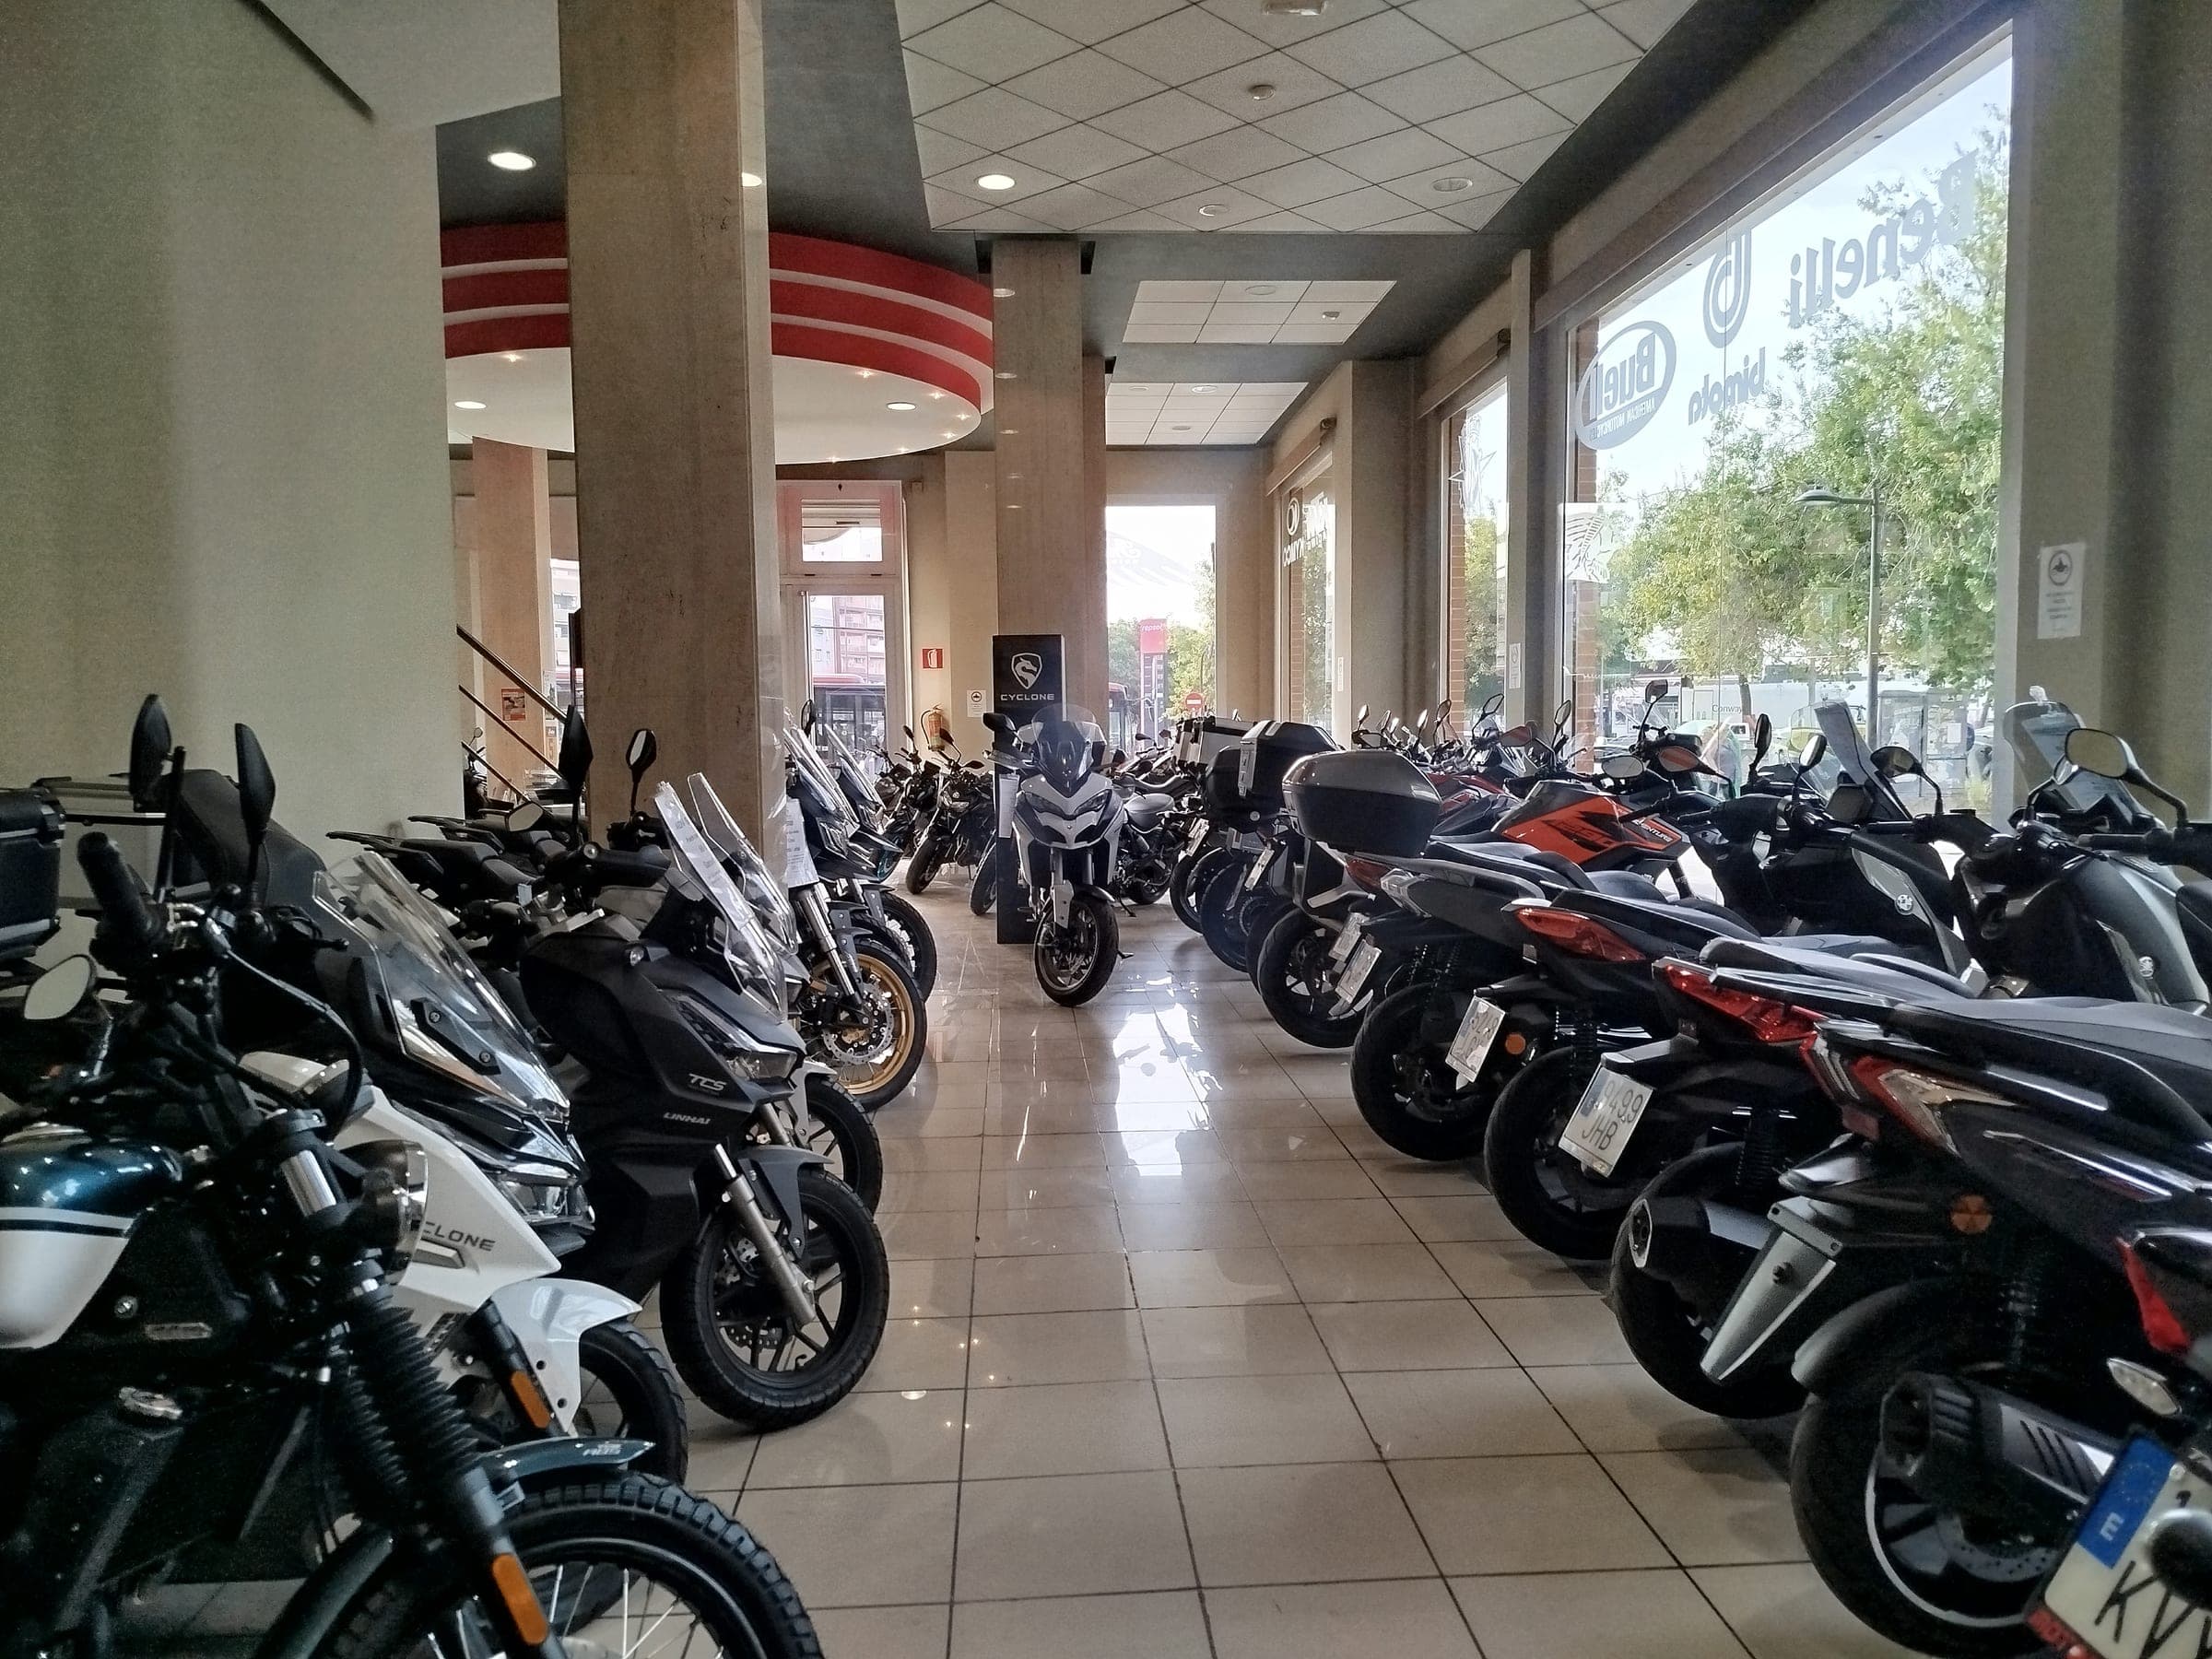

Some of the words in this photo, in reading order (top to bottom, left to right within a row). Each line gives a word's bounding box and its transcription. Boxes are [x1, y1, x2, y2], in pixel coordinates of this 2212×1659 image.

[1000, 693, 1055, 701] CYCLONE
[688, 1073, 727, 1091] TCS
[1605, 1079, 1643, 1124] 9499
[664, 1112, 711, 1124] LINHAI
[1582, 1113, 1618, 1150] JHB
[421, 1220, 496, 1252] CLONE
[2093, 1559, 2212, 1659] KV
